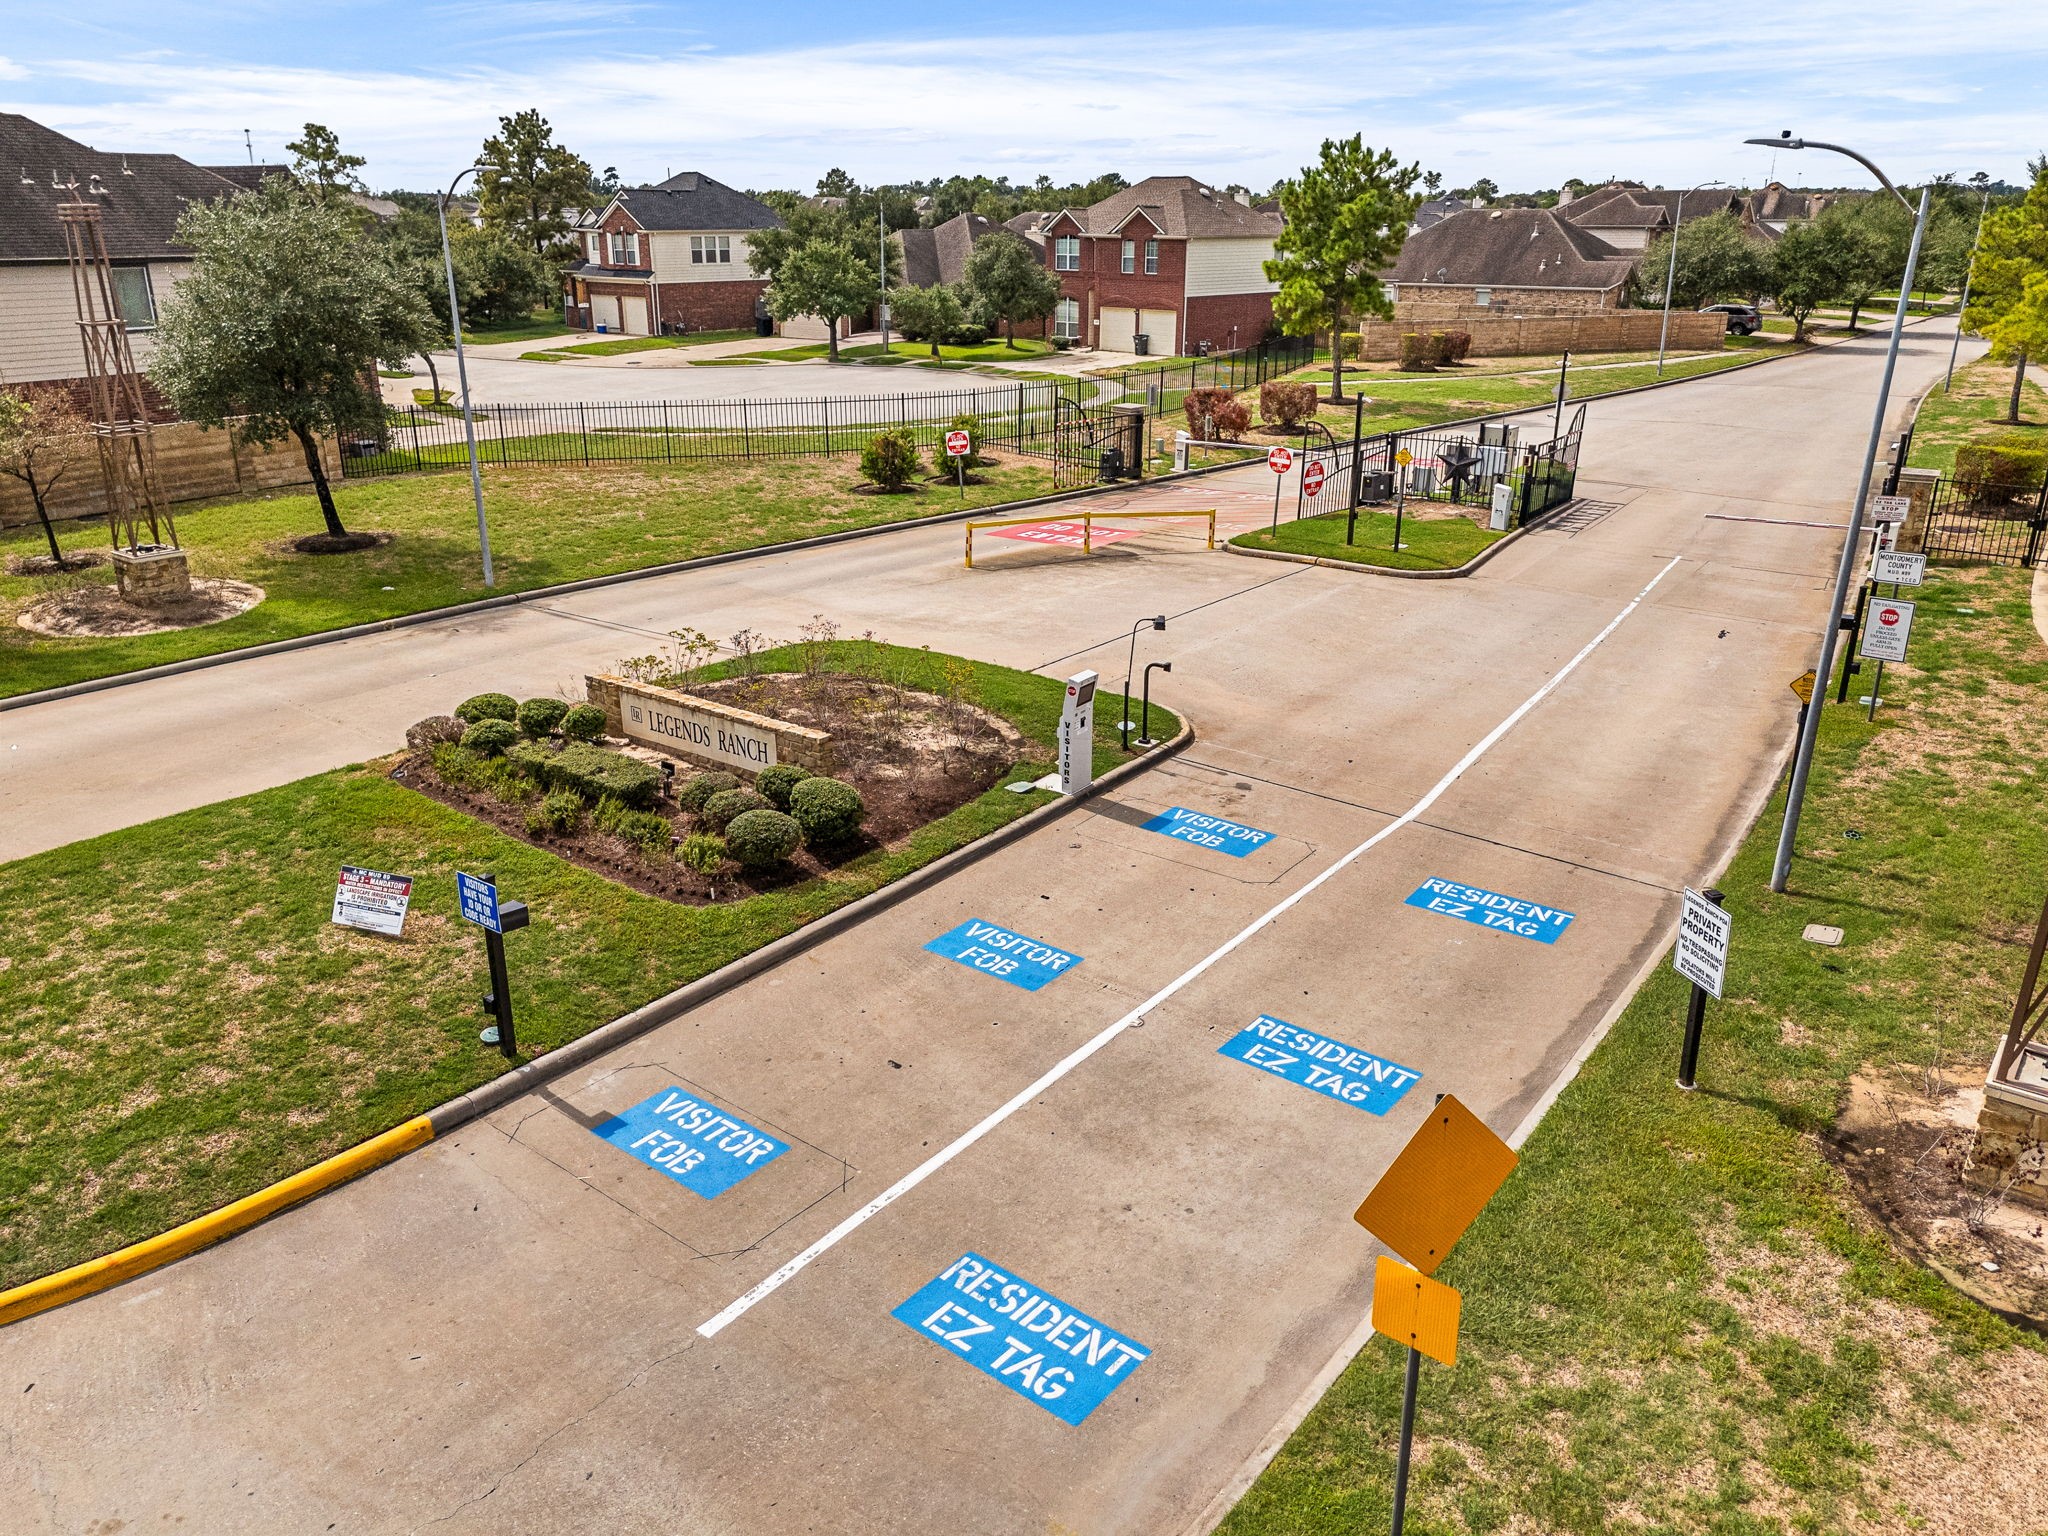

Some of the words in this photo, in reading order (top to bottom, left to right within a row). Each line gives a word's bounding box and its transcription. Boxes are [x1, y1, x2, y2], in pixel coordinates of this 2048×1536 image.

[1017, 530, 1092, 544] ENTER
[1040, 523, 1074, 532] DO
[1880, 553, 1924, 565] MONTGOMERY
[1888, 561, 1913, 570] COUNTY
[1880, 613, 1898, 621] STOP
[647, 710, 711, 747] LEGENDS
[717, 729, 769, 764] RANCH
[1170, 826, 1225, 847] FOB
[1173, 809, 1266, 843] VISITOR
[343, 873, 360, 882] STAGE
[370, 878, 406, 890] MANDATORY
[346, 887, 370, 897] LANDSCAPE
[371, 891, 398, 901] IRRIGATION
[464, 876, 489, 895] VISITORS
[357, 895, 388, 906] PROHIBITED
[463, 886, 478, 900] HAVE
[478, 892, 493, 907] YOUR
[467, 899, 474, 909] ID
[474, 901, 482, 913] OR
[1421, 878, 1574, 926] RESIDENT
[1686, 895, 1704, 911] LEGENDS
[1704, 906, 1719, 920] RANCH
[1719, 916, 1728, 926] POA
[464, 907, 479, 921] CODE
[479, 913, 497, 929] READY
[1426, 897, 1475, 918] EZ
[1482, 910, 1540, 936] TAG
[1688, 907, 1722, 937] PRIVATE
[965, 922, 1071, 970] VISITOR
[1682, 917, 1725, 952] PROPERTY
[956, 946, 1019, 975] FOB
[1680, 933, 1688, 943] NO
[1689, 938, 1723, 967] TRESPASSING
[1682, 942, 1690, 952] NO
[1690, 947, 1719, 973] SOLICITING
[1680, 962, 1687, 970] BE
[1687, 966, 1715, 990] PROSECUTED
[1681, 956, 1705, 975] VIOLATORS
[1705, 971, 1716, 984] WILL
[1245, 1017, 1420, 1088] RESIDENT
[1242, 1043, 1299, 1073] EZ
[1304, 1064, 1371, 1101] TAG
[653, 1092, 774, 1165] VISITOR
[630, 1129, 706, 1174] FOB
[939, 1256, 1147, 1377] RESIDENT
[921, 1301, 995, 1352] EZ
[990, 1335, 1075, 1400] TAG
